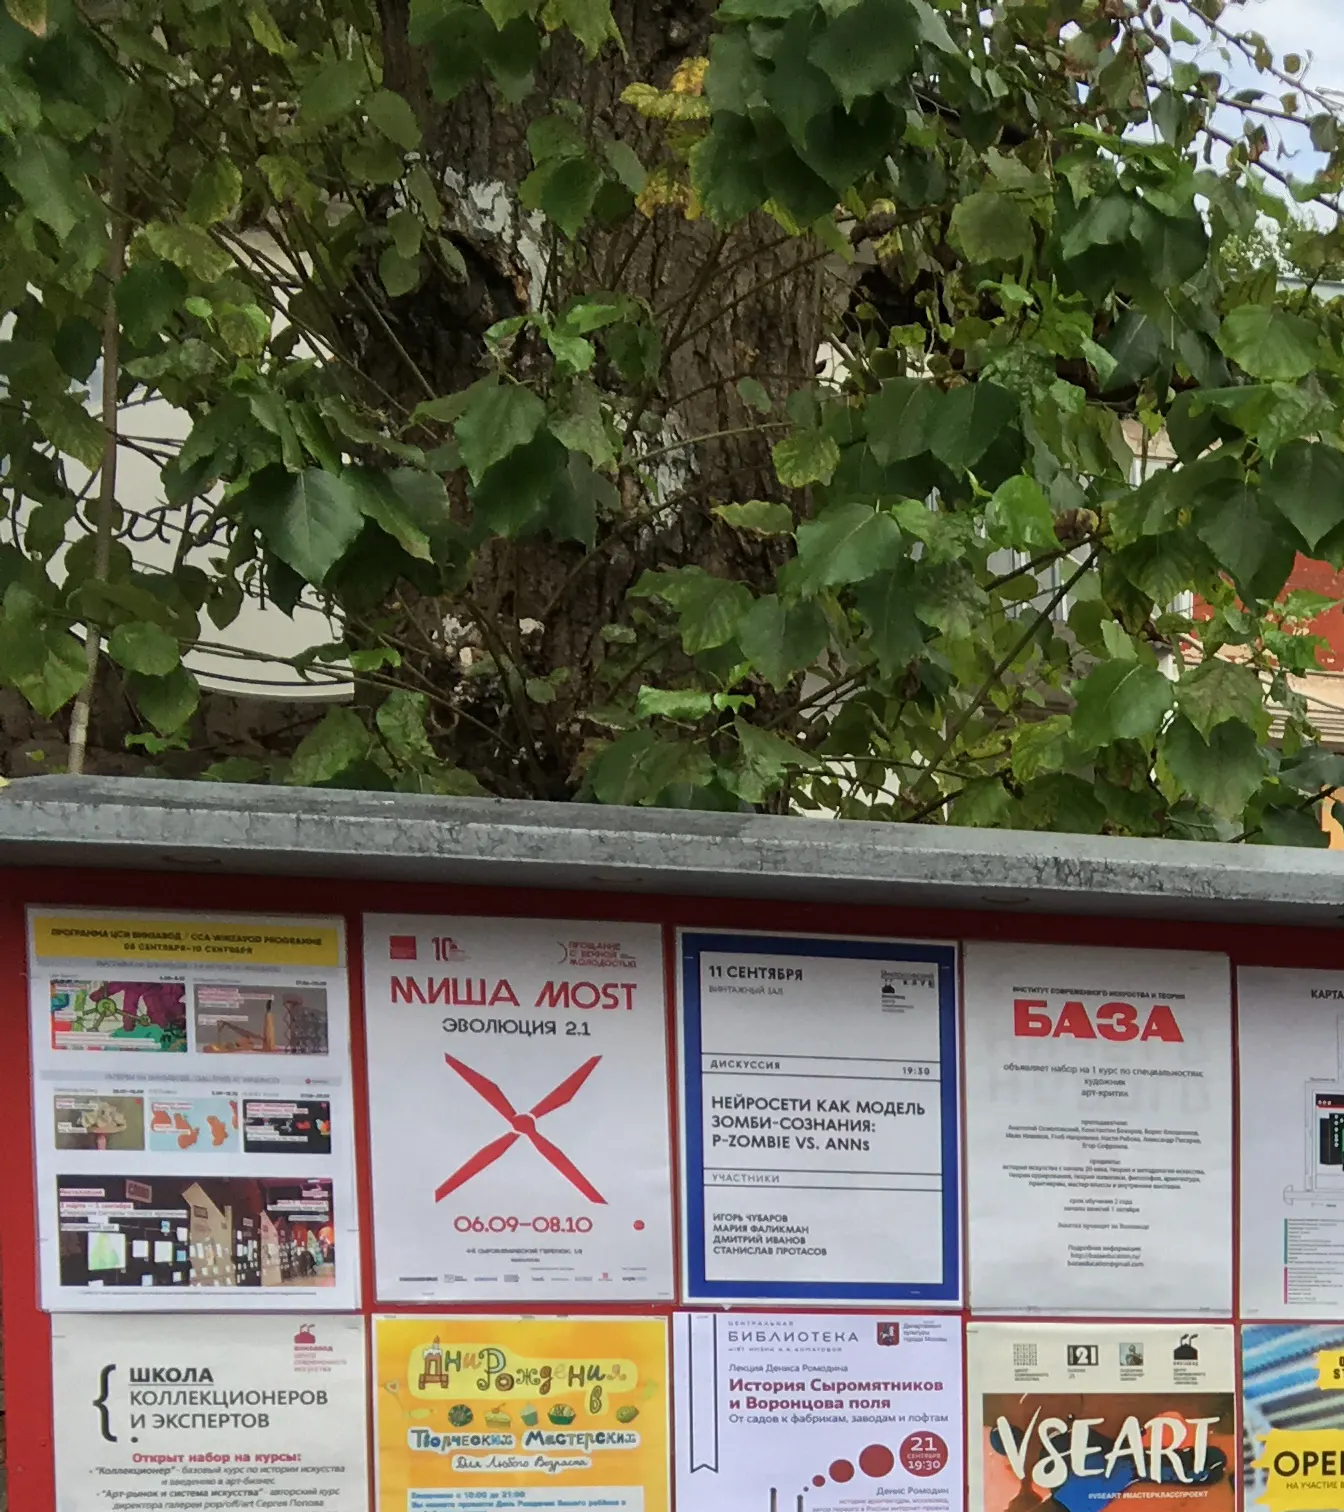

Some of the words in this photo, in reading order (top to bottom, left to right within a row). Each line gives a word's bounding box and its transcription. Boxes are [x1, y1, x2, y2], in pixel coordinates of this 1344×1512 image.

[708, 965, 722, 978] 11
[727, 965, 803, 981] СЕНТЯБРЯ
[390, 975, 520, 1008] МИША
[534, 980, 637, 1010] MOST
[1311, 989, 1344, 1000] КАРТА
[1014, 998, 1184, 1042] БАЗА
[442, 1018, 556, 1037] ЭВОЛЮЦИЯ
[565, 1021, 591, 1036] 2.1
[710, 1059, 781, 1071] ДИСКУССИЯ
[1003, 1063, 1049, 1073] объявляет
[1051, 1064, 1077, 1075] набор
[1098, 1068, 1117, 1077] курс
[1081, 1089, 1129, 1098] арт-критик
[711, 1094, 811, 1112] НЕЙРОСЕТИ
[816, 1100, 850, 1113] КАК
[856, 1101, 925, 1117] МОДЕЛЬ
[711, 1115, 876, 1133] ЗОМБИ-СОЗНАНИЯ:
[712, 1134, 790, 1149] P-ZOMBIE
[795, 1136, 820, 1150] VS.
[825, 1137, 870, 1151] ANNs
[712, 1173, 780, 1183] УЧАСТНИКИ
[713, 1213, 744, 1222] ИГОРЬ
[746, 1213, 788, 1223] ЧУБАРОВ
[713, 1224, 748, 1233] МАРИЯ
[750, 1225, 809, 1234] ФАЛИКМАН
[713, 1234, 763, 1245] ДМИТРИЙ
[765, 1236, 806, 1245] ИВАНОВ
[713, 1246, 773, 1255] СТАНИСЛАВ
[776, 1247, 827, 1256] ПРОТАСОВ
[728, 1331, 859, 1343] БИБЛИОТЕКА
[129, 1367, 214, 1383] ШКОЛА
[728, 1363, 764, 1374] Лекция
[765, 1364, 800, 1375] Дениса
[802, 1364, 849, 1373] Ромодина
[728, 1378, 806, 1395] История
[810, 1378, 944, 1396] Сыромятников
[130, 1390, 328, 1409] КОЛЛЕКЦИОНЕРОВ
[729, 1399, 741, 1409] и
[746, 1396, 844, 1412] Воронцова
[849, 1399, 891, 1409] поля
[130, 1414, 146, 1429] И
[152, 1413, 270, 1429] ЭКСПЕРТОВ
[728, 1414, 745, 1423] От
[747, 1415, 779, 1425] садов
[781, 1415, 788, 1423] к
[790, 1413, 849, 1426] фабрикам,
[851, 1415, 896, 1424] заводам
[908, 1413, 949, 1424] лофтам
[910, 1436, 938, 1451] 21
[996, 1405, 1220, 1489] VSEART
[132, 1453, 184, 1465] Открыт
[189, 1452, 230, 1464] набор
[235, 1453, 250, 1462] на
[255, 1453, 302, 1464] курсы:
[455, 1456, 482, 1469] Для
[486, 1455, 530, 1468] Любого
[534, 1456, 588, 1473] Возраста
[907, 1460, 941, 1471] 19:30
[876, 1487, 906, 1497] Денис
[907, 1487, 949, 1495] Ромодин
[1286, 1482, 1298, 1490] НА
[1299, 1481, 1337, 1490] УЧАСТИЕ
